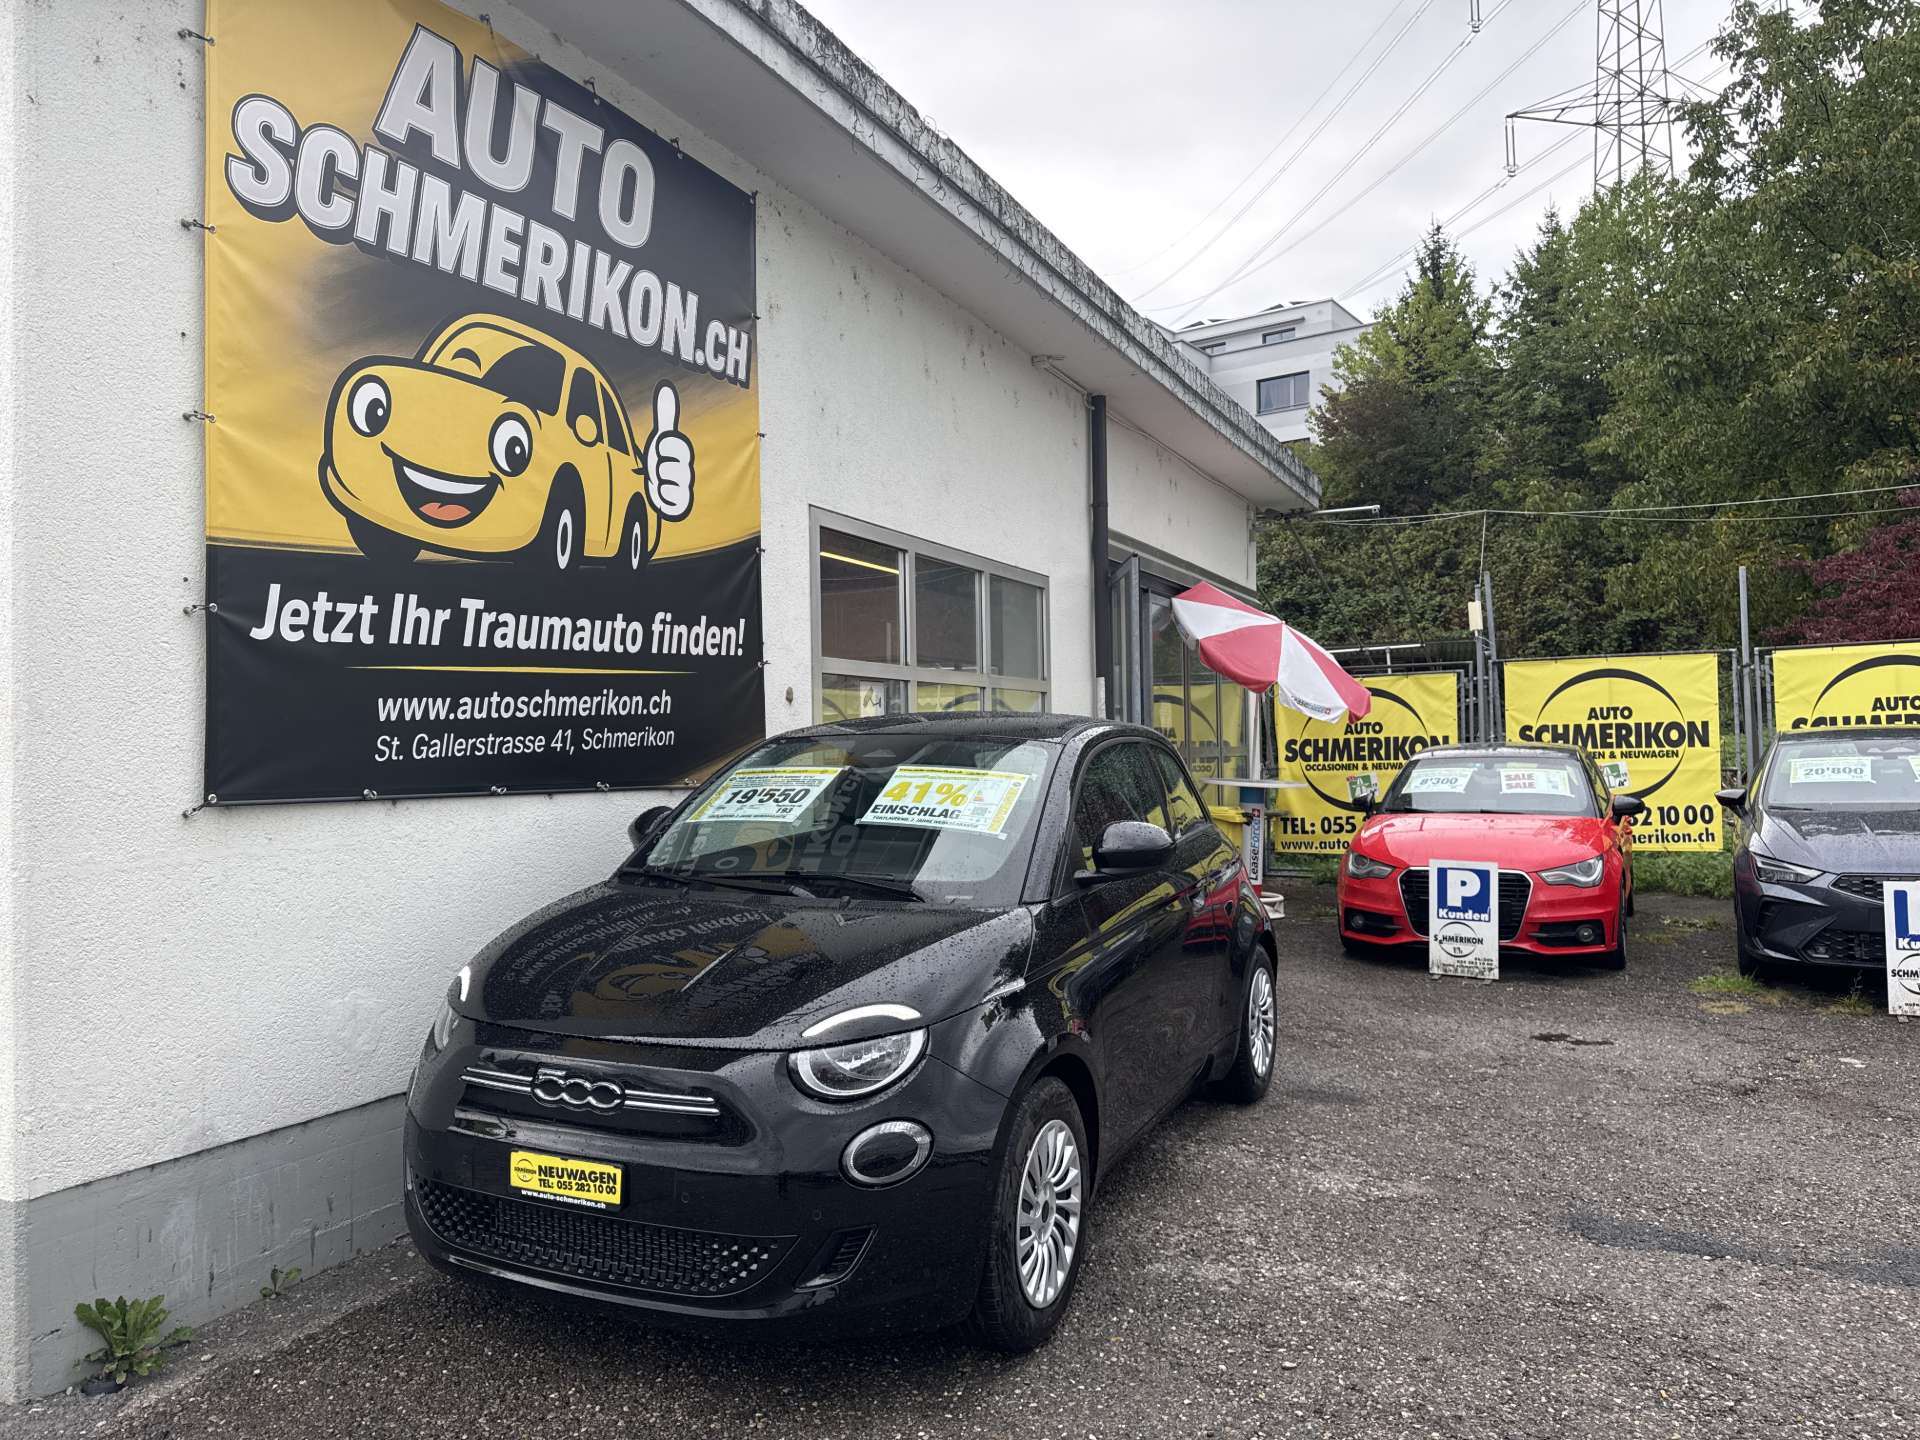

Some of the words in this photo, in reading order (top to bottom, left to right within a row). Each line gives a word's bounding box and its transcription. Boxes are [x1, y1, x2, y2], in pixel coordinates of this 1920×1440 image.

[375, 24, 656, 249] AUTO
[227, 95, 750, 383] SCHMERIKON.CH
[249, 583, 377, 644] Jetzt
[388, 592, 450, 647] Ihr
[460, 598, 644, 655] Traumauto
[651, 614, 746, 657] finden!
[377, 689, 672, 722] www.autoschmerikon.ch
[1587, 706, 1633, 721] AUTO
[1344, 722, 1383, 735] AUTO
[1518, 720, 1710, 750] SCHMERIKON
[374, 733, 404, 762] St.
[412, 727, 545, 760] Gallerstrasse
[550, 729, 575, 757] 41,
[581, 726, 675, 752] Schmerikon
[1608, 750, 1617, 760] &
[1620, 749, 1680, 760] NEUWAGEN
[1304, 761, 1359, 772] OCCASIONEN
[1361, 762, 1369, 771] &
[1371, 761, 1406, 771] NEUWA
[725, 787, 811, 805] 19'550
[883, 780, 969, 807] 41%
[870, 804, 963, 820] EINSCHLAG
[1659, 806, 1680, 826] 10
[1684, 805, 1714, 825] 00
[1280, 817, 1316, 835] TEL:
[1320, 816, 1357, 834] 055
[1447, 869, 1481, 907] P
[1438, 908, 1490, 922] Kunden
[535, 1067, 624, 1109] 500
[537, 1165, 617, 1185] NEUWAGEN
[538, 1178, 554, 1189] TEL:
[556, 1180, 573, 1191] 055
[574, 1182, 592, 1193] 282
[593, 1184, 604, 1194] 10
[605, 1185, 617, 1195] 00
[521, 1189, 606, 1209] www.auto-schmerikon.ch
